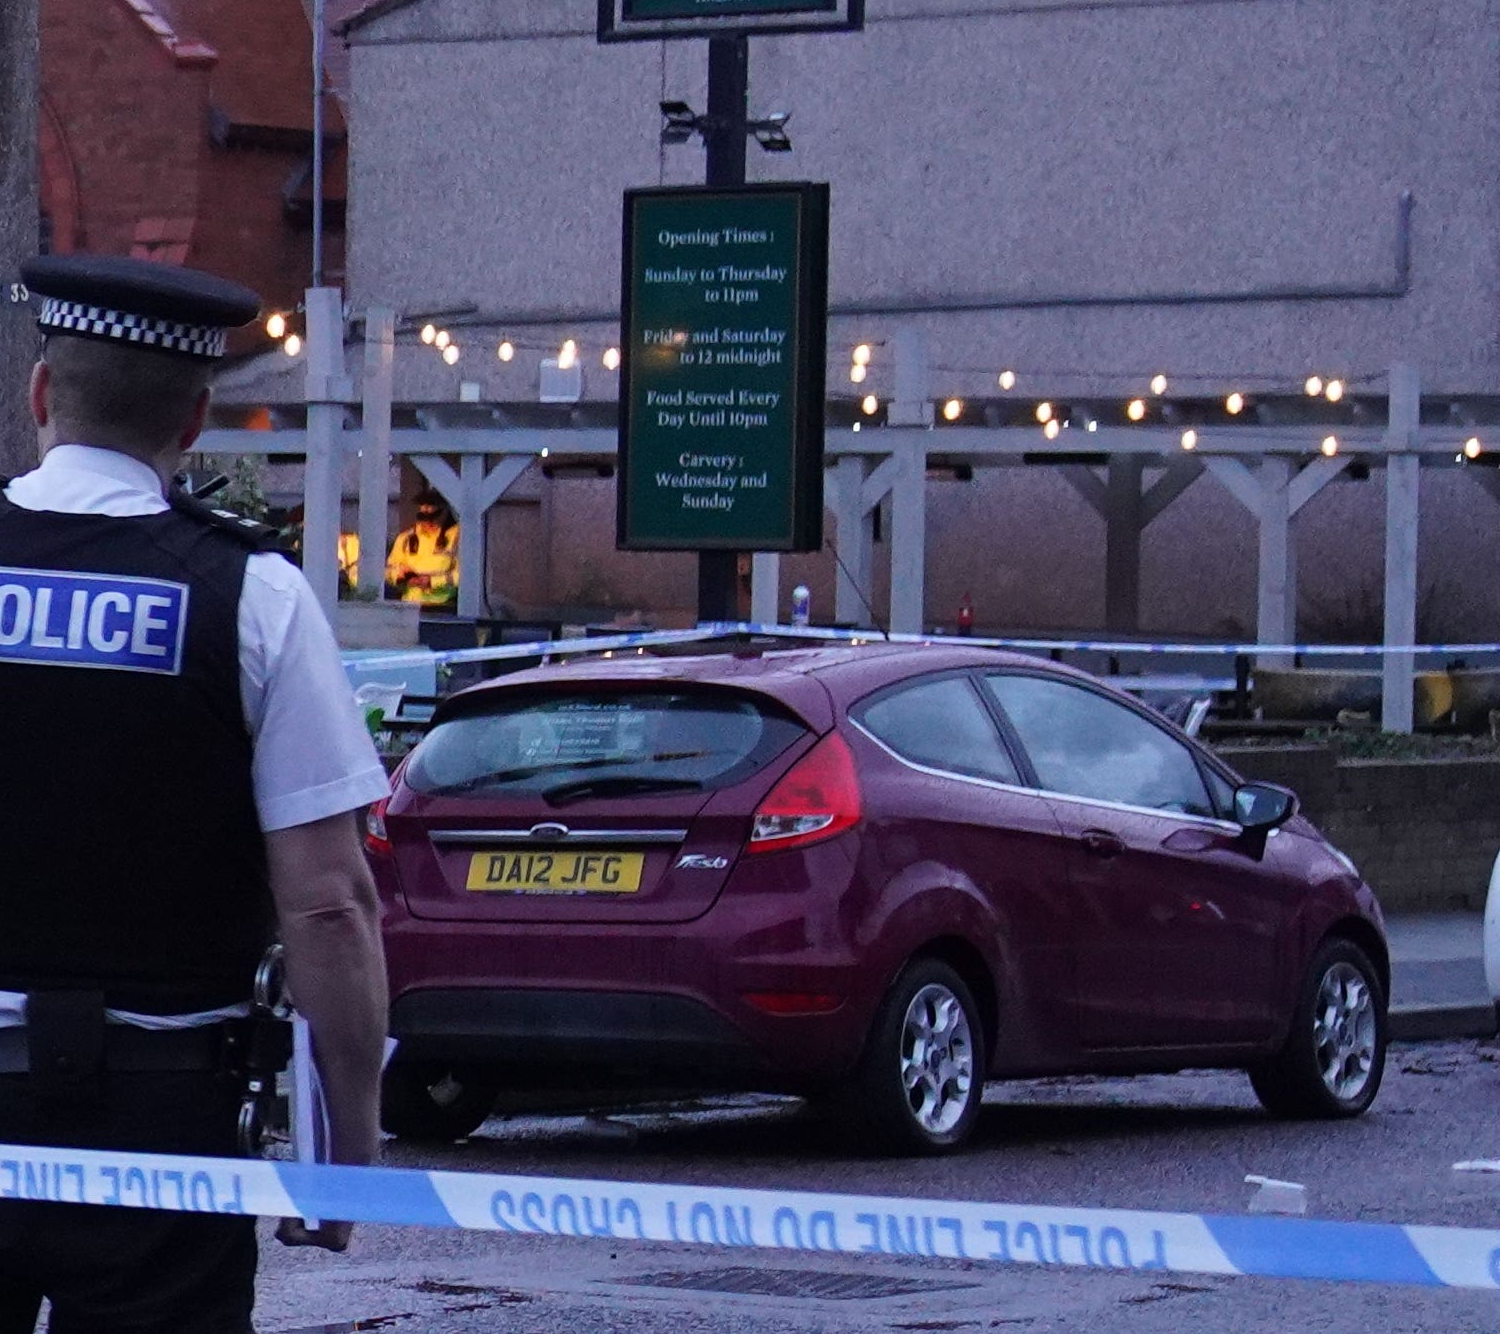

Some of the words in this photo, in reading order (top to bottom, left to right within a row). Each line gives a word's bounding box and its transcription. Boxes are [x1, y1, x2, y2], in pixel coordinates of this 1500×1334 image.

[658, 228, 719, 248] Opening
[722, 227, 767, 244] Times
[644, 266, 696, 285] Sunday
[700, 269, 715, 282] to
[717, 264, 788, 284] Thursday
[704, 289, 719, 303] to
[723, 286, 759, 306] 11pm
[643, 328, 690, 347] Friday
[692, 327, 718, 344] and
[721, 326, 786, 346] Saturday
[679, 351, 694, 364] to
[698, 350, 713, 364] 12
[716, 347, 782, 367] midnight
[647, 388, 682, 406] Food
[685, 388, 735, 406] Served
[738, 388, 781, 408] Every
[658, 411, 685, 430] Day
[689, 409, 725, 427] Until
[729, 410, 768, 430] 10pm
[678, 451, 738, 471] Carvery
[655, 471, 738, 491] Wednesday
[740, 469, 768, 488] and
[681, 492, 735, 512] Sunday
[485, 854, 554, 884] DA12
[561, 855, 622, 884] JFG
